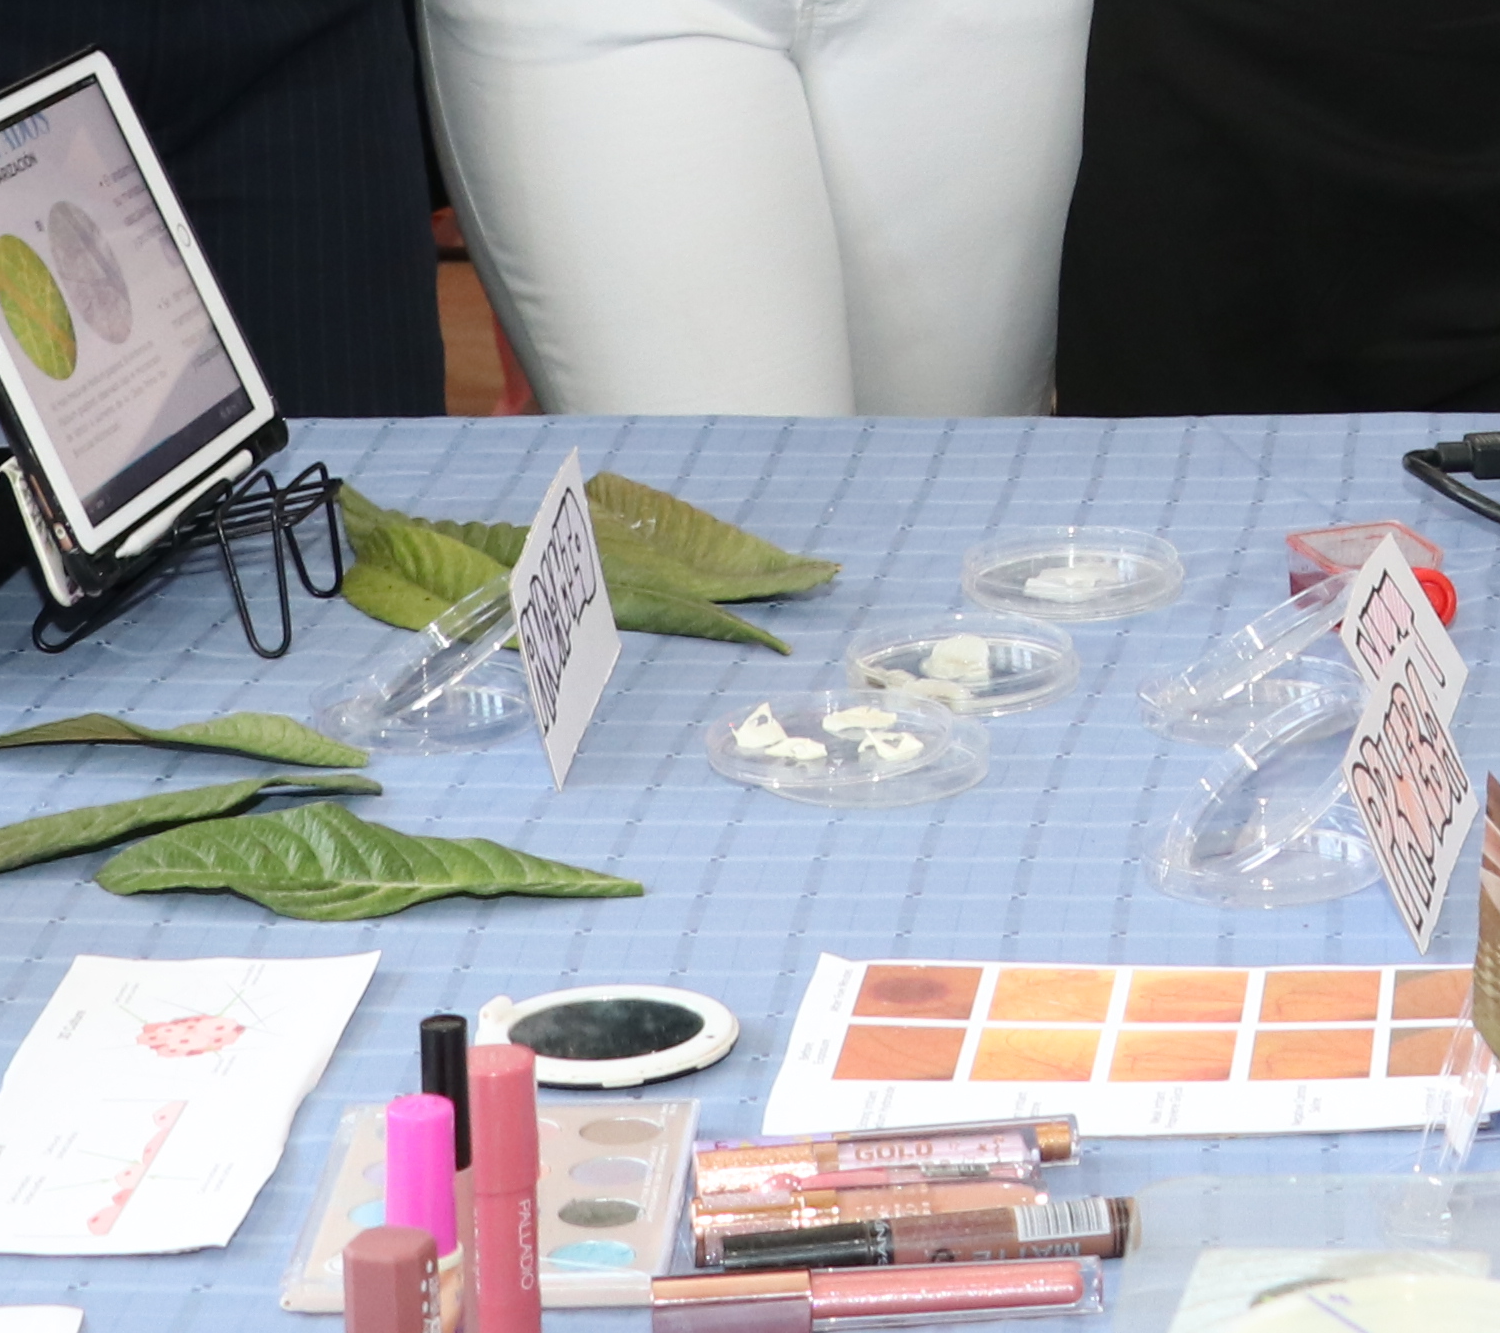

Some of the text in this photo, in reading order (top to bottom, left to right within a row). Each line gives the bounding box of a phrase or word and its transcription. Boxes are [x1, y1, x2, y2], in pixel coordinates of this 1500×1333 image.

[520, 486, 598, 734] ANDAMIO
[1351, 658, 1469, 935] PRUEBA
[854, 1142, 933, 1163] GOLD
[517, 1198, 536, 1291] PALLADIO
